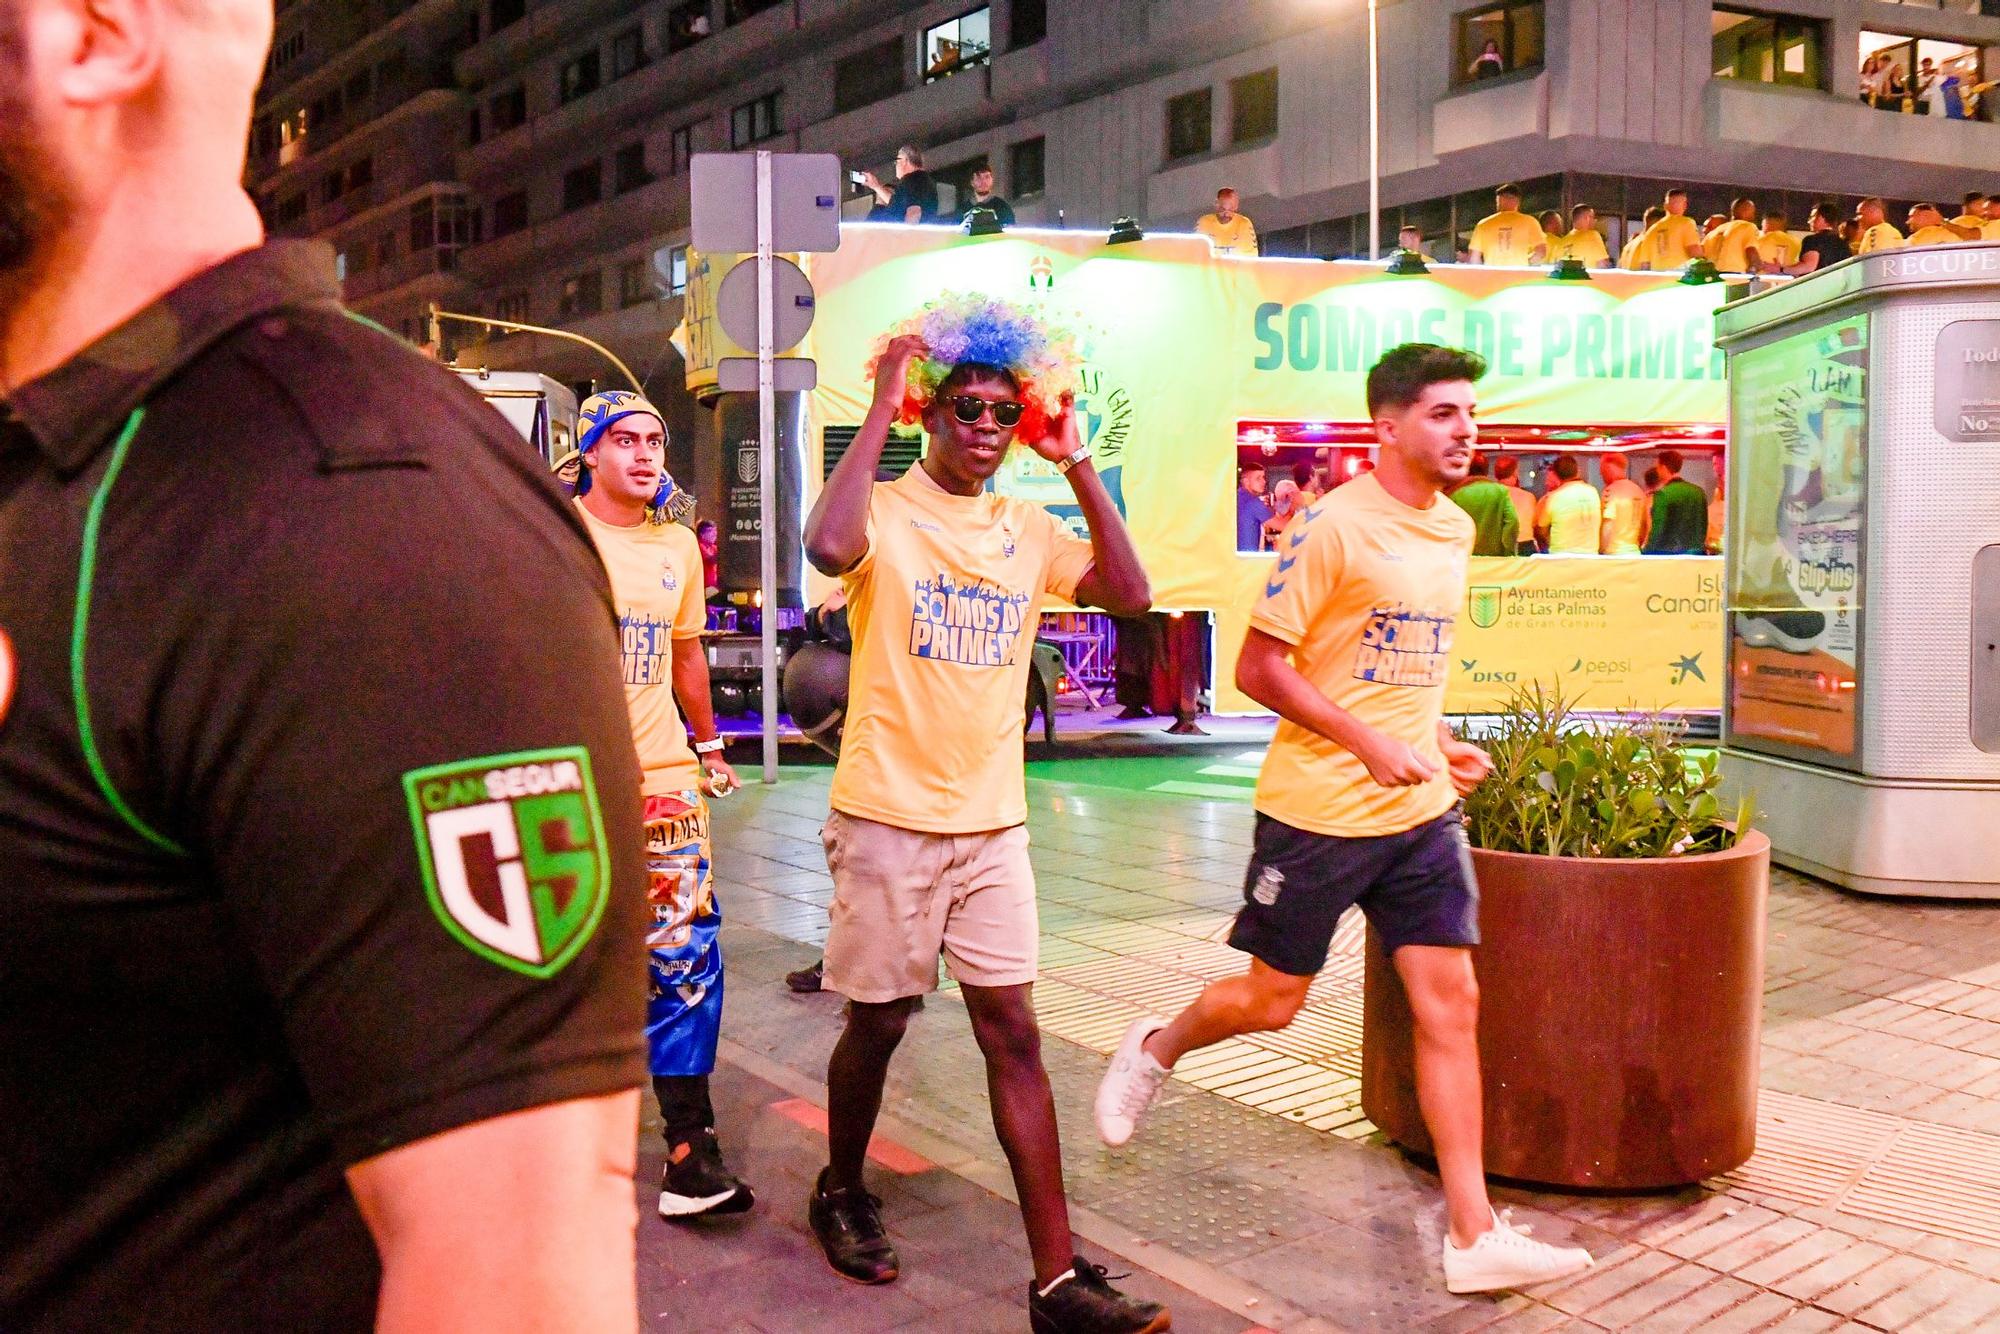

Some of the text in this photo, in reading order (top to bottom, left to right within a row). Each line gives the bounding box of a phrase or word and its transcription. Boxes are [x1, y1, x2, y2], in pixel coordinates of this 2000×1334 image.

[1882, 251, 2000, 278] RECUPE
[1254, 303, 1727, 380] SOMOS DE PRIME
[1961, 415, 1988, 431] No
[1697, 573, 1723, 593] Isl
[1798, 560, 1855, 597] Slip-ins
[1507, 586, 1607, 602] Ayuntamiento
[1646, 594, 1723, 613] Canari
[913, 588, 1001, 632] SOMOS
[1507, 602, 1607, 615] de Las Palmas
[621, 652, 665, 685] MERA
[1585, 657, 1632, 676] pepsi
